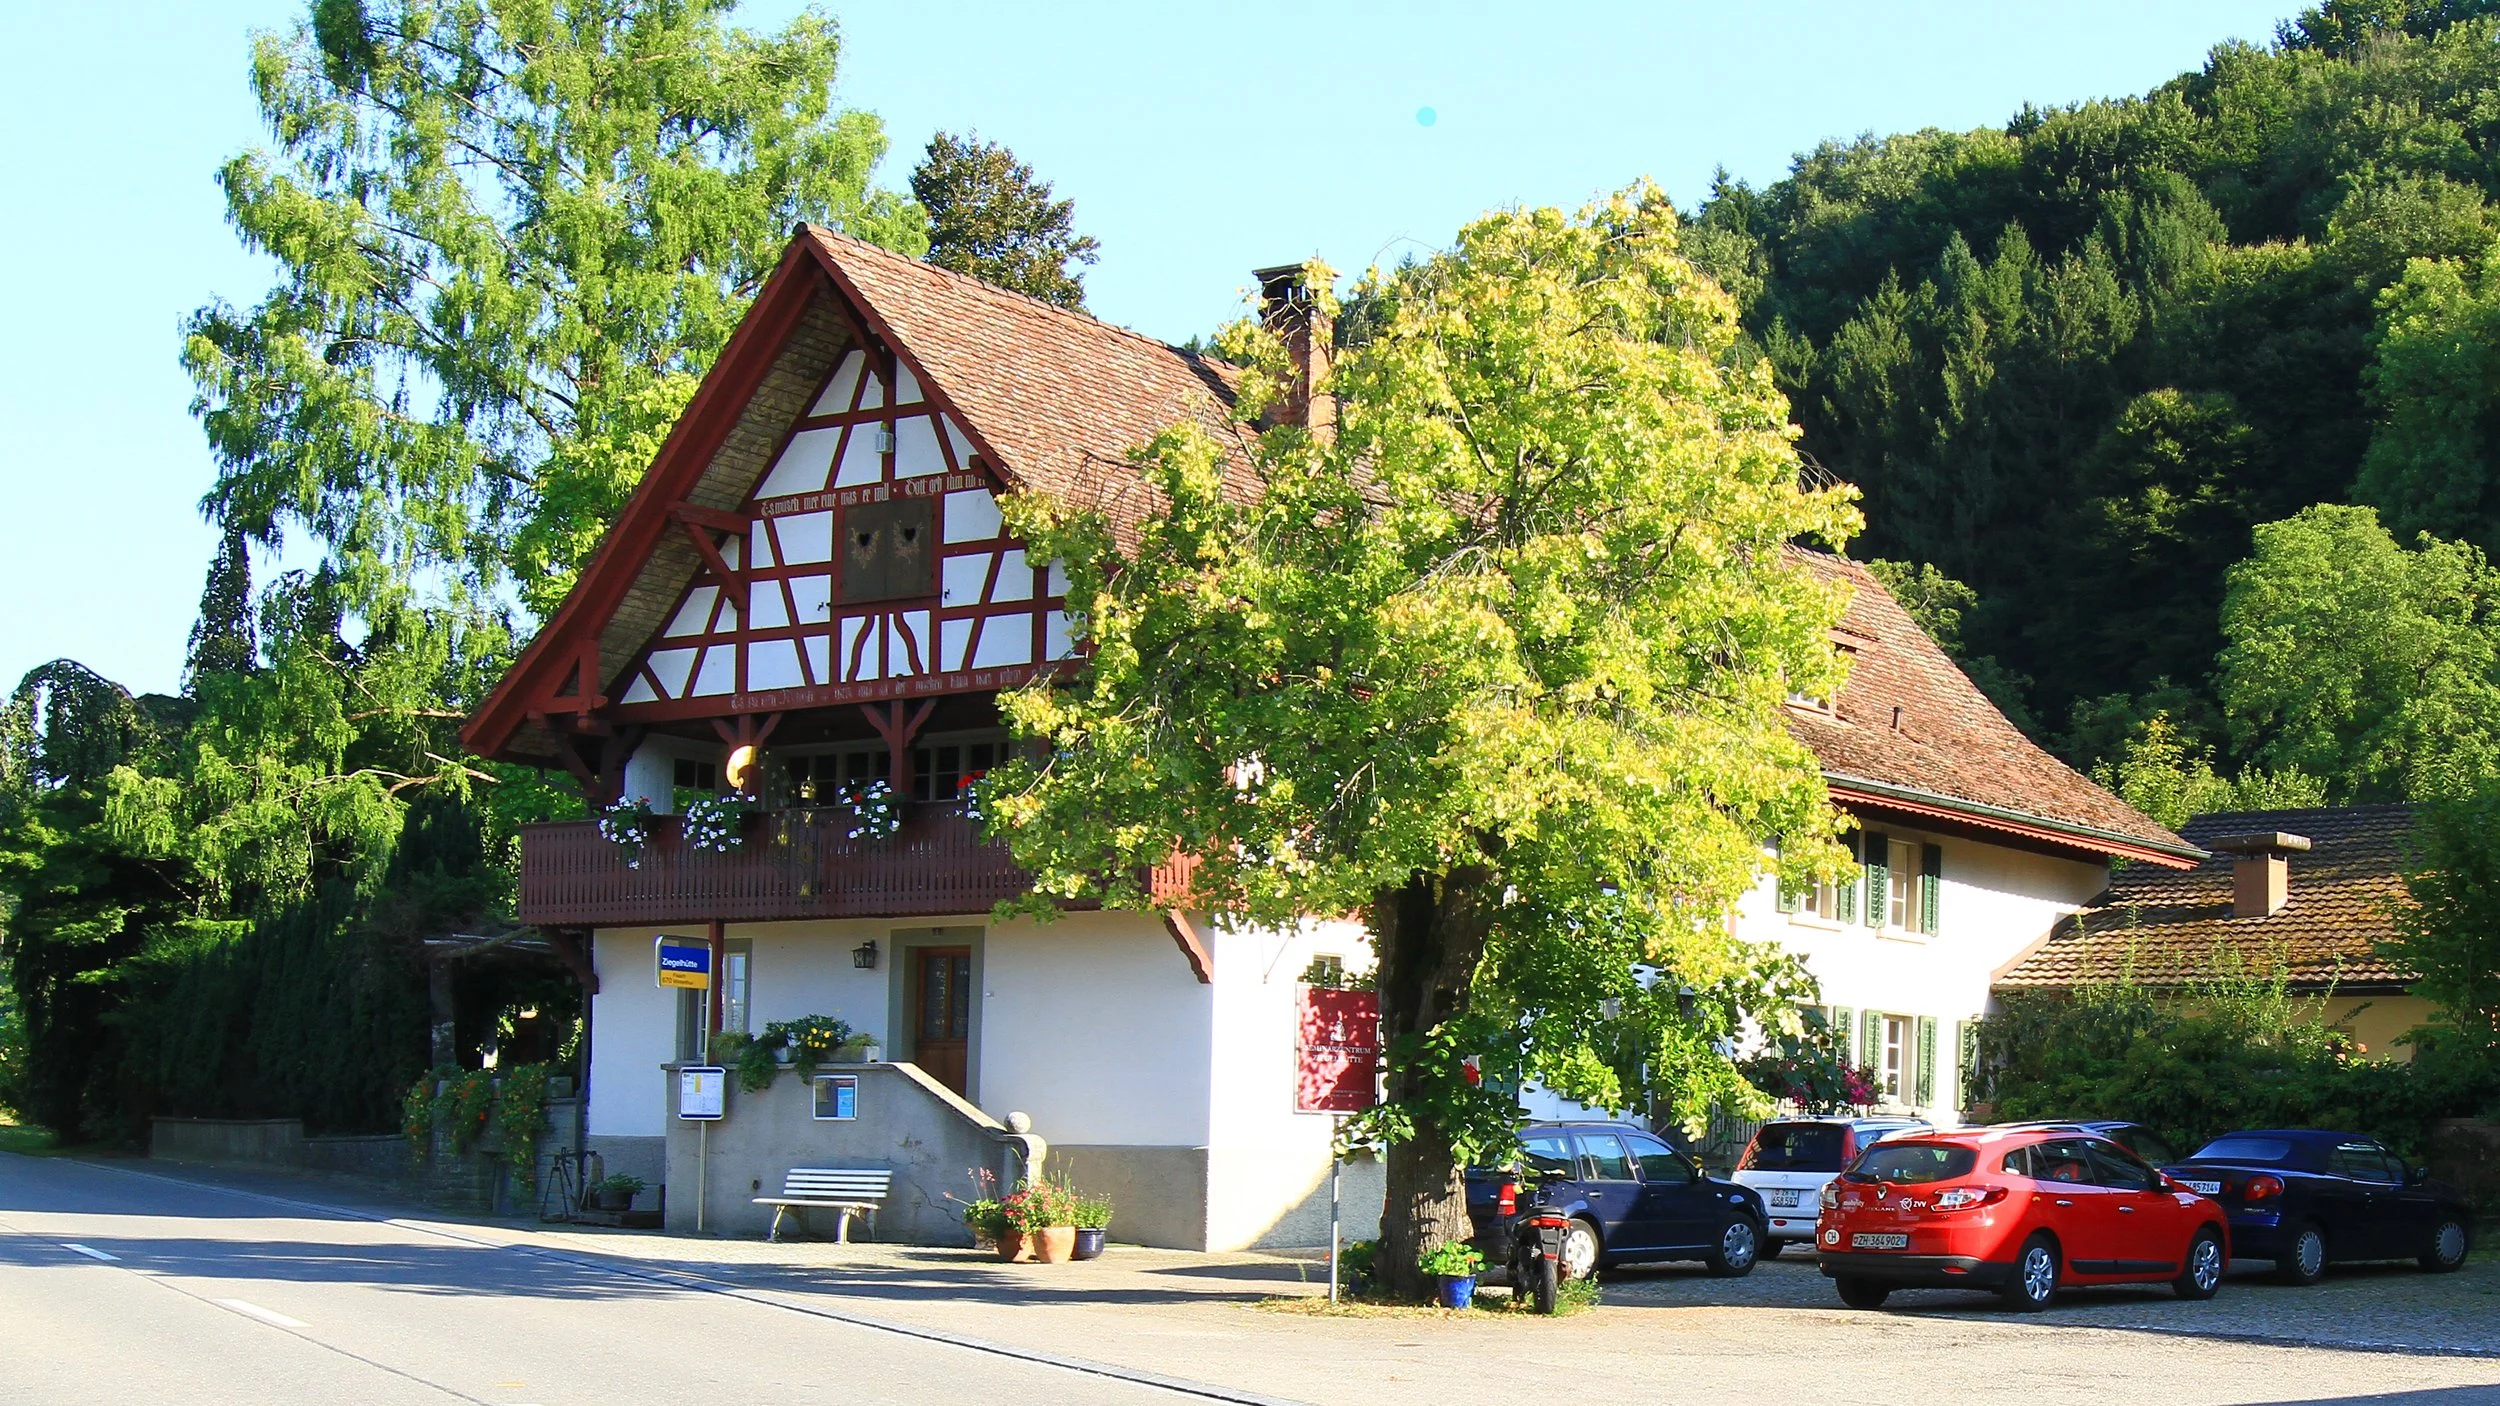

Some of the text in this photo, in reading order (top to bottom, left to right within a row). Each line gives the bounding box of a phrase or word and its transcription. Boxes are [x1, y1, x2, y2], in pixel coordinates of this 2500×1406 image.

[662, 957, 698, 968] Ziegelhütte
[1827, 1231, 1837, 1242] CH
[1858, 1235, 1900, 1246] ZH 364902
